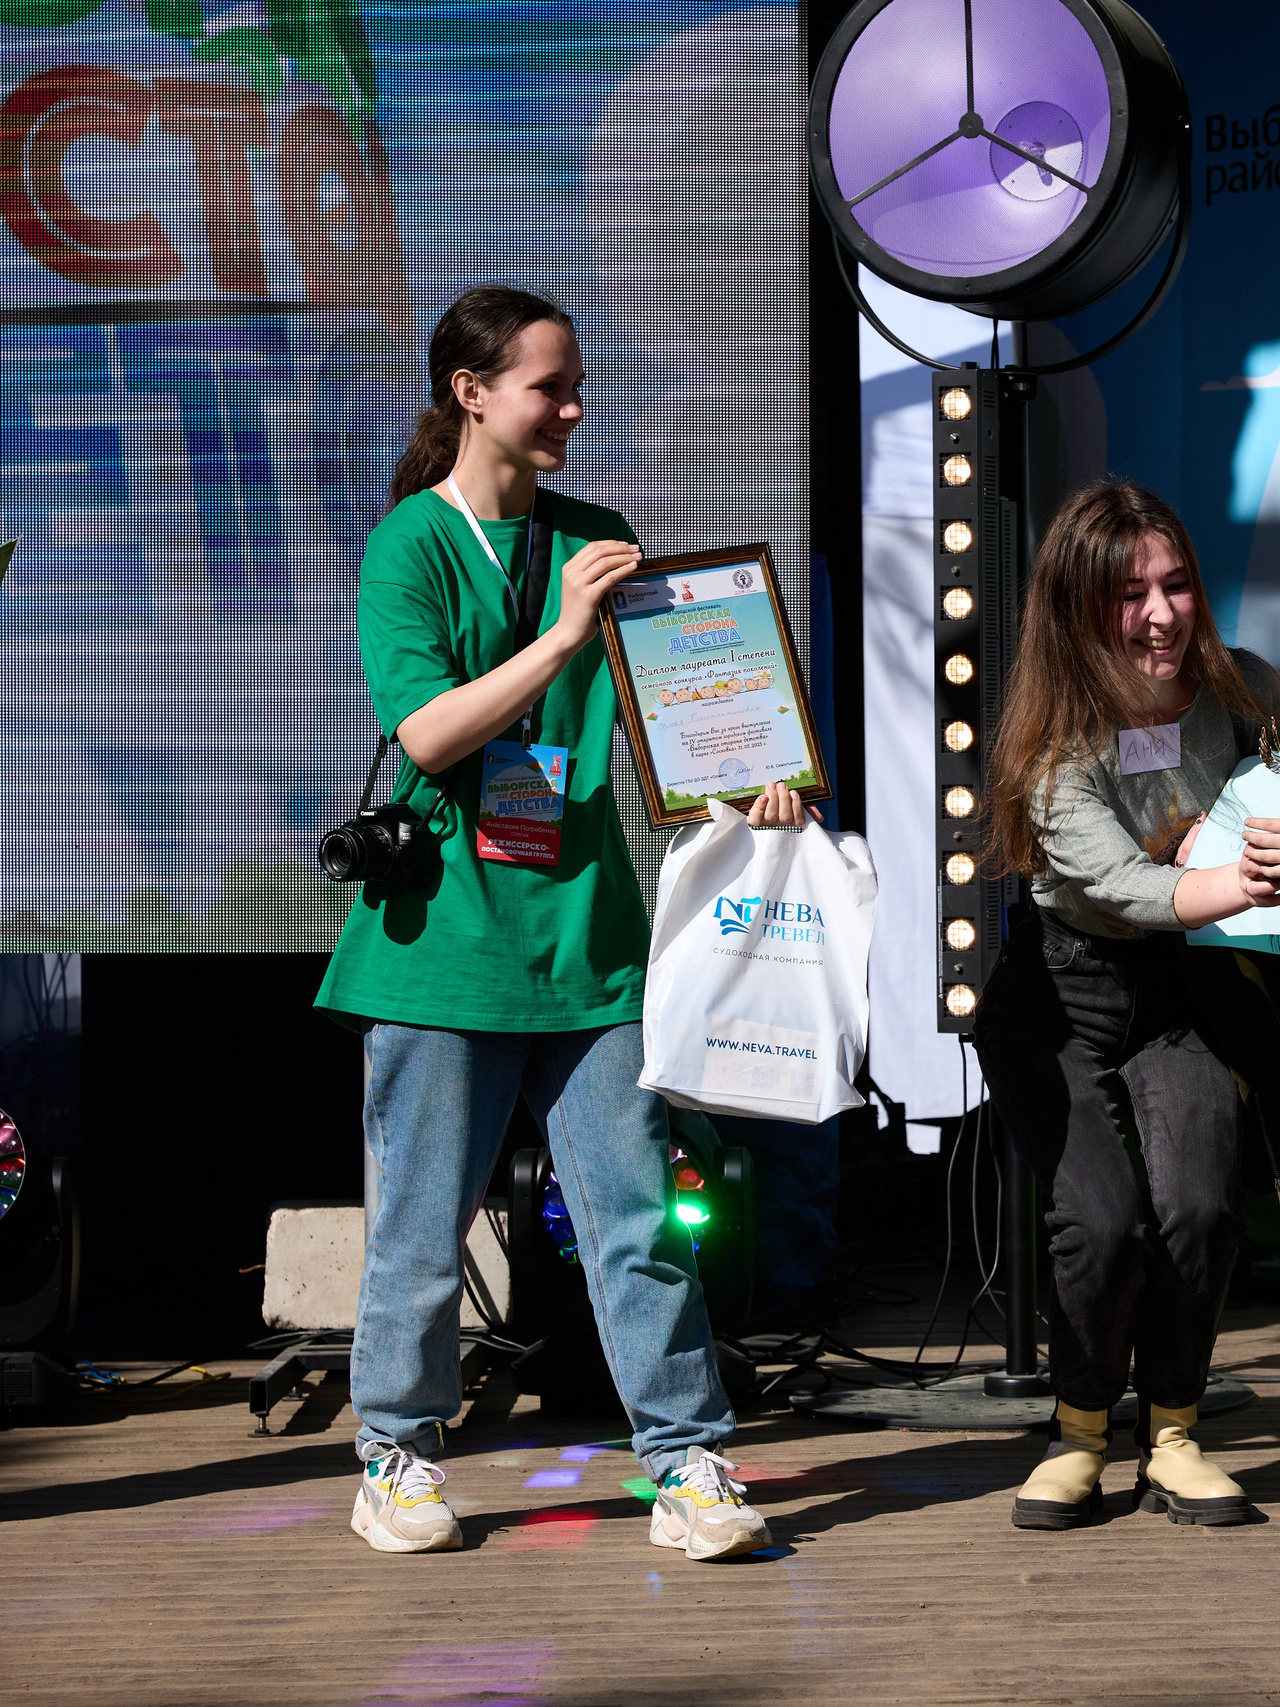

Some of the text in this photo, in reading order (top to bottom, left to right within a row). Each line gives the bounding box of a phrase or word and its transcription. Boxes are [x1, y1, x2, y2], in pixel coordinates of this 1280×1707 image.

[652, 607, 731, 629] ВЫБОРГСКАЯ
[682, 618, 738, 635] СТОРОНА
[669, 628, 741, 655] ДЕТСТВА
[635, 664, 677, 678] Диплом
[680, 656, 726, 672] лауреата
[738, 649, 776, 661] степени
[641, 680, 673, 690] семейного
[674, 675, 702, 686] конкурса
[509, 788, 559, 800] СТОРОНА
[496, 797, 560, 816] ДЕТСТВА
[764, 899, 825, 928] НЕВА
[761, 923, 826, 945] ТРЕВЕЛ
[713, 947, 824, 966] СУДОХОДНАЯ КОМПАНИЯ
[705, 1037, 818, 1060] WWW.NEVA.TRAVEL
